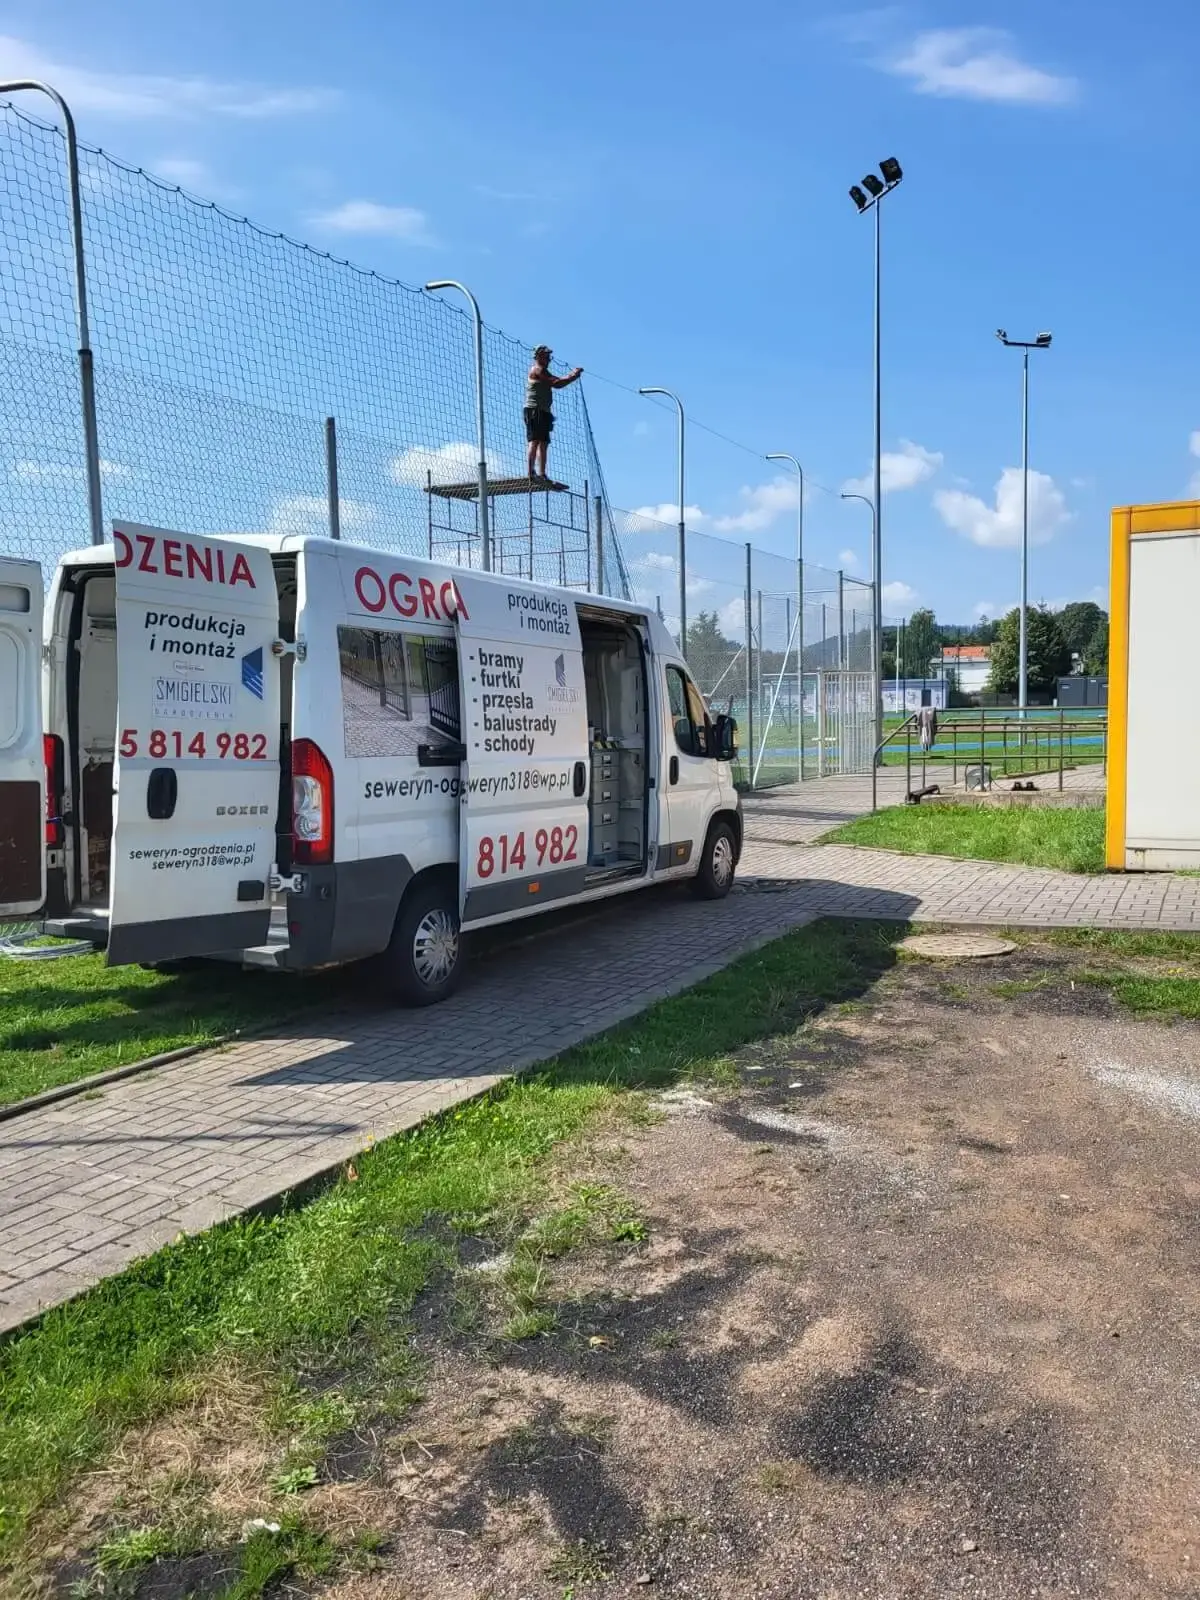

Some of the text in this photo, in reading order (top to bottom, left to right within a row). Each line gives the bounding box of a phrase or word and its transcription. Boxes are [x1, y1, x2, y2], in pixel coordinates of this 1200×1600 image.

[508, 593, 568, 617] produkcja
[144, 611, 246, 639] produkcja
[520, 612, 571, 636] i montaż
[150, 634, 235, 659] i montaż
[478, 647, 524, 674] bramy
[156, 676, 232, 704] ŚMIGIELSKI
[480, 668, 521, 689] furtki
[483, 713, 557, 736] balustrady
[119, 729, 267, 760] 5 814 982
[484, 733, 535, 756] schody
[216, 805, 269, 816] BOXER
[129, 842, 256, 861] seweryn-ogrodzenia.pl
[152, 853, 254, 870] seweryn318@wp.pl
[477, 824, 578, 878] 814 982
